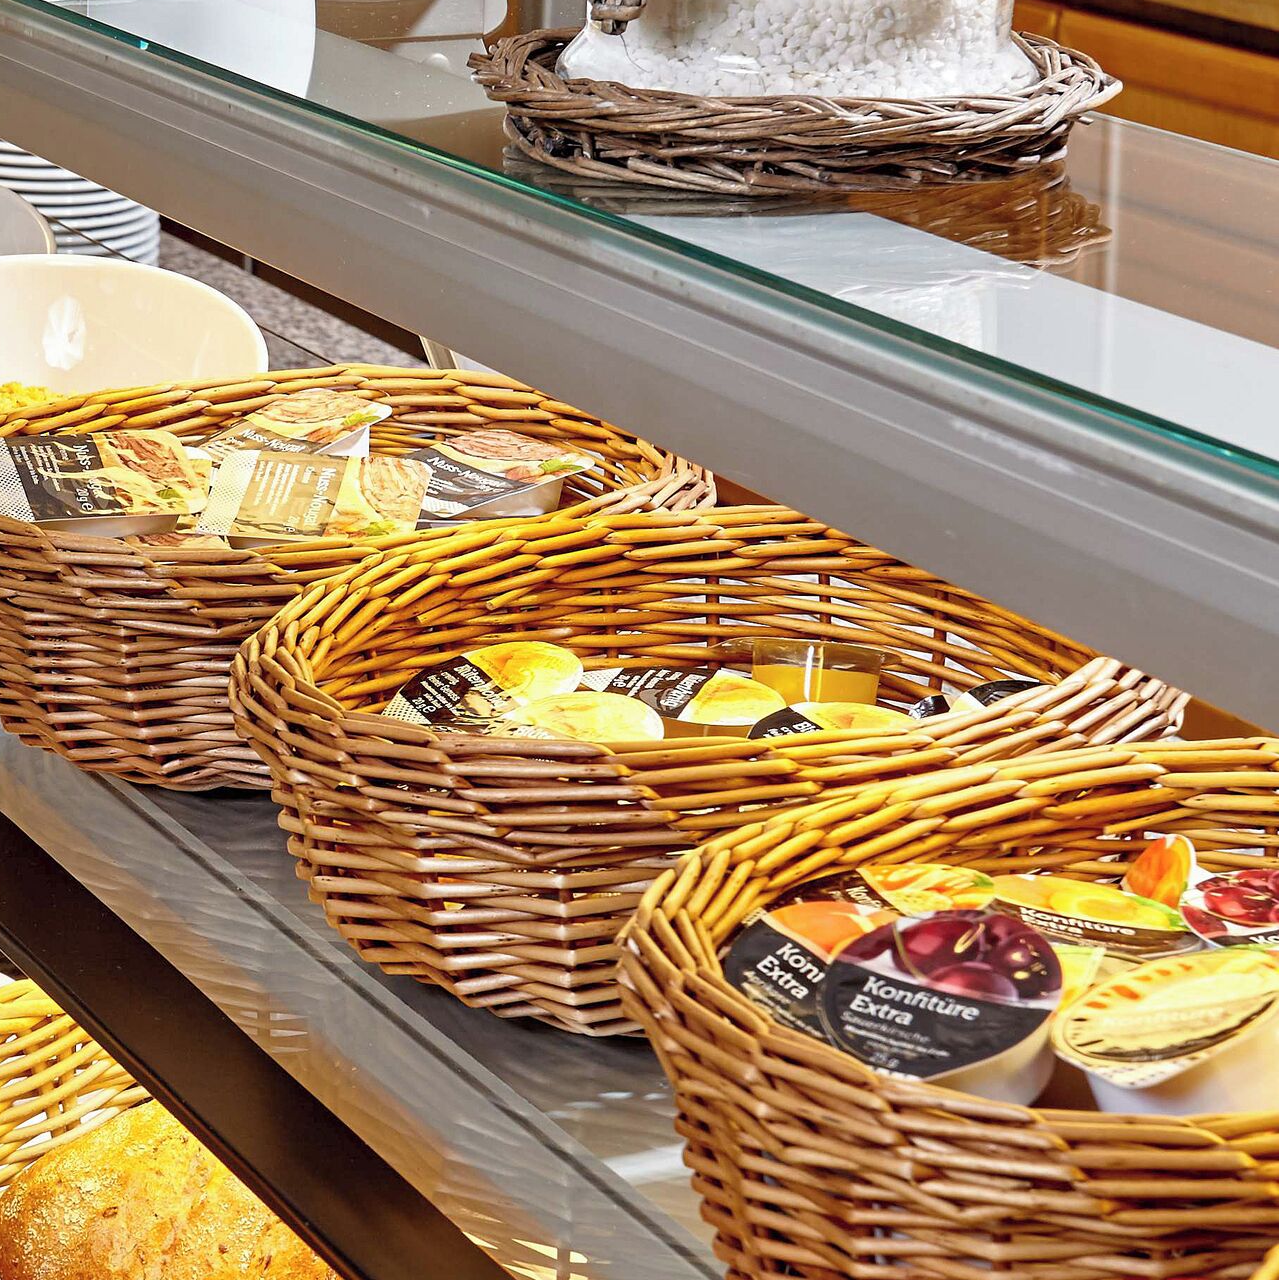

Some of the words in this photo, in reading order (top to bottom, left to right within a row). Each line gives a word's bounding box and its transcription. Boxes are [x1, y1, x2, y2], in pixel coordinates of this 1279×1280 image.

[1020, 907, 1137, 936] Konfitüre
[757, 955, 810, 1000] Extra
[850, 994, 914, 1026] Extra
[863, 976, 980, 1021] Konfitüre
